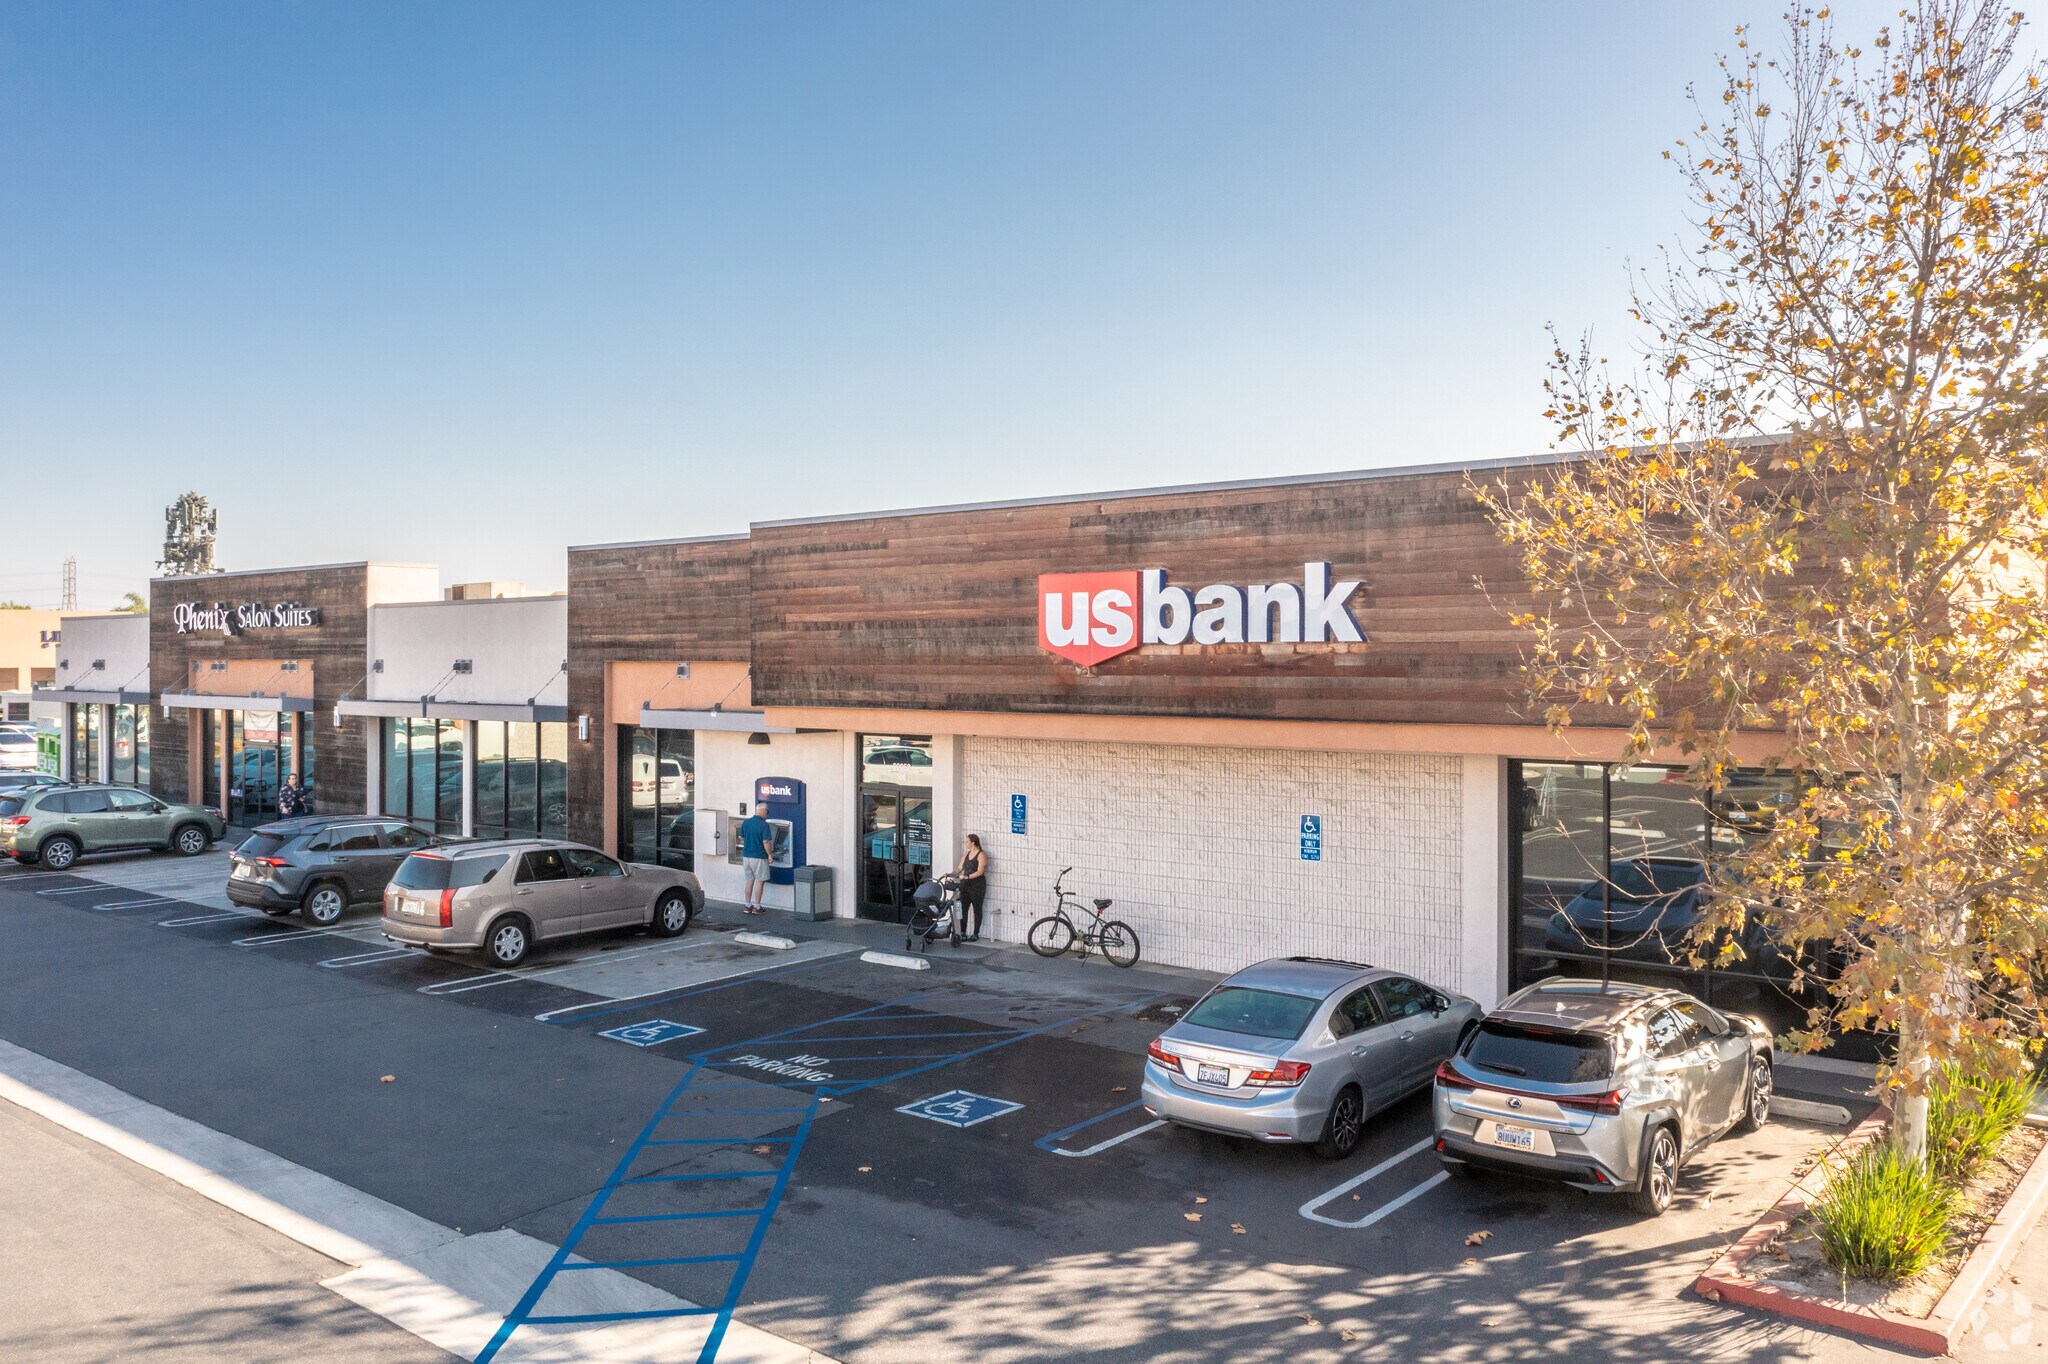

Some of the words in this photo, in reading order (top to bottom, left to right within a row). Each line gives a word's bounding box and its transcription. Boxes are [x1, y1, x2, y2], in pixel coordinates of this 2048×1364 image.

[174, 602, 231, 636] Phenix
[728, 1054, 834, 1082] PARKING
[786, 1054, 830, 1067] NO
